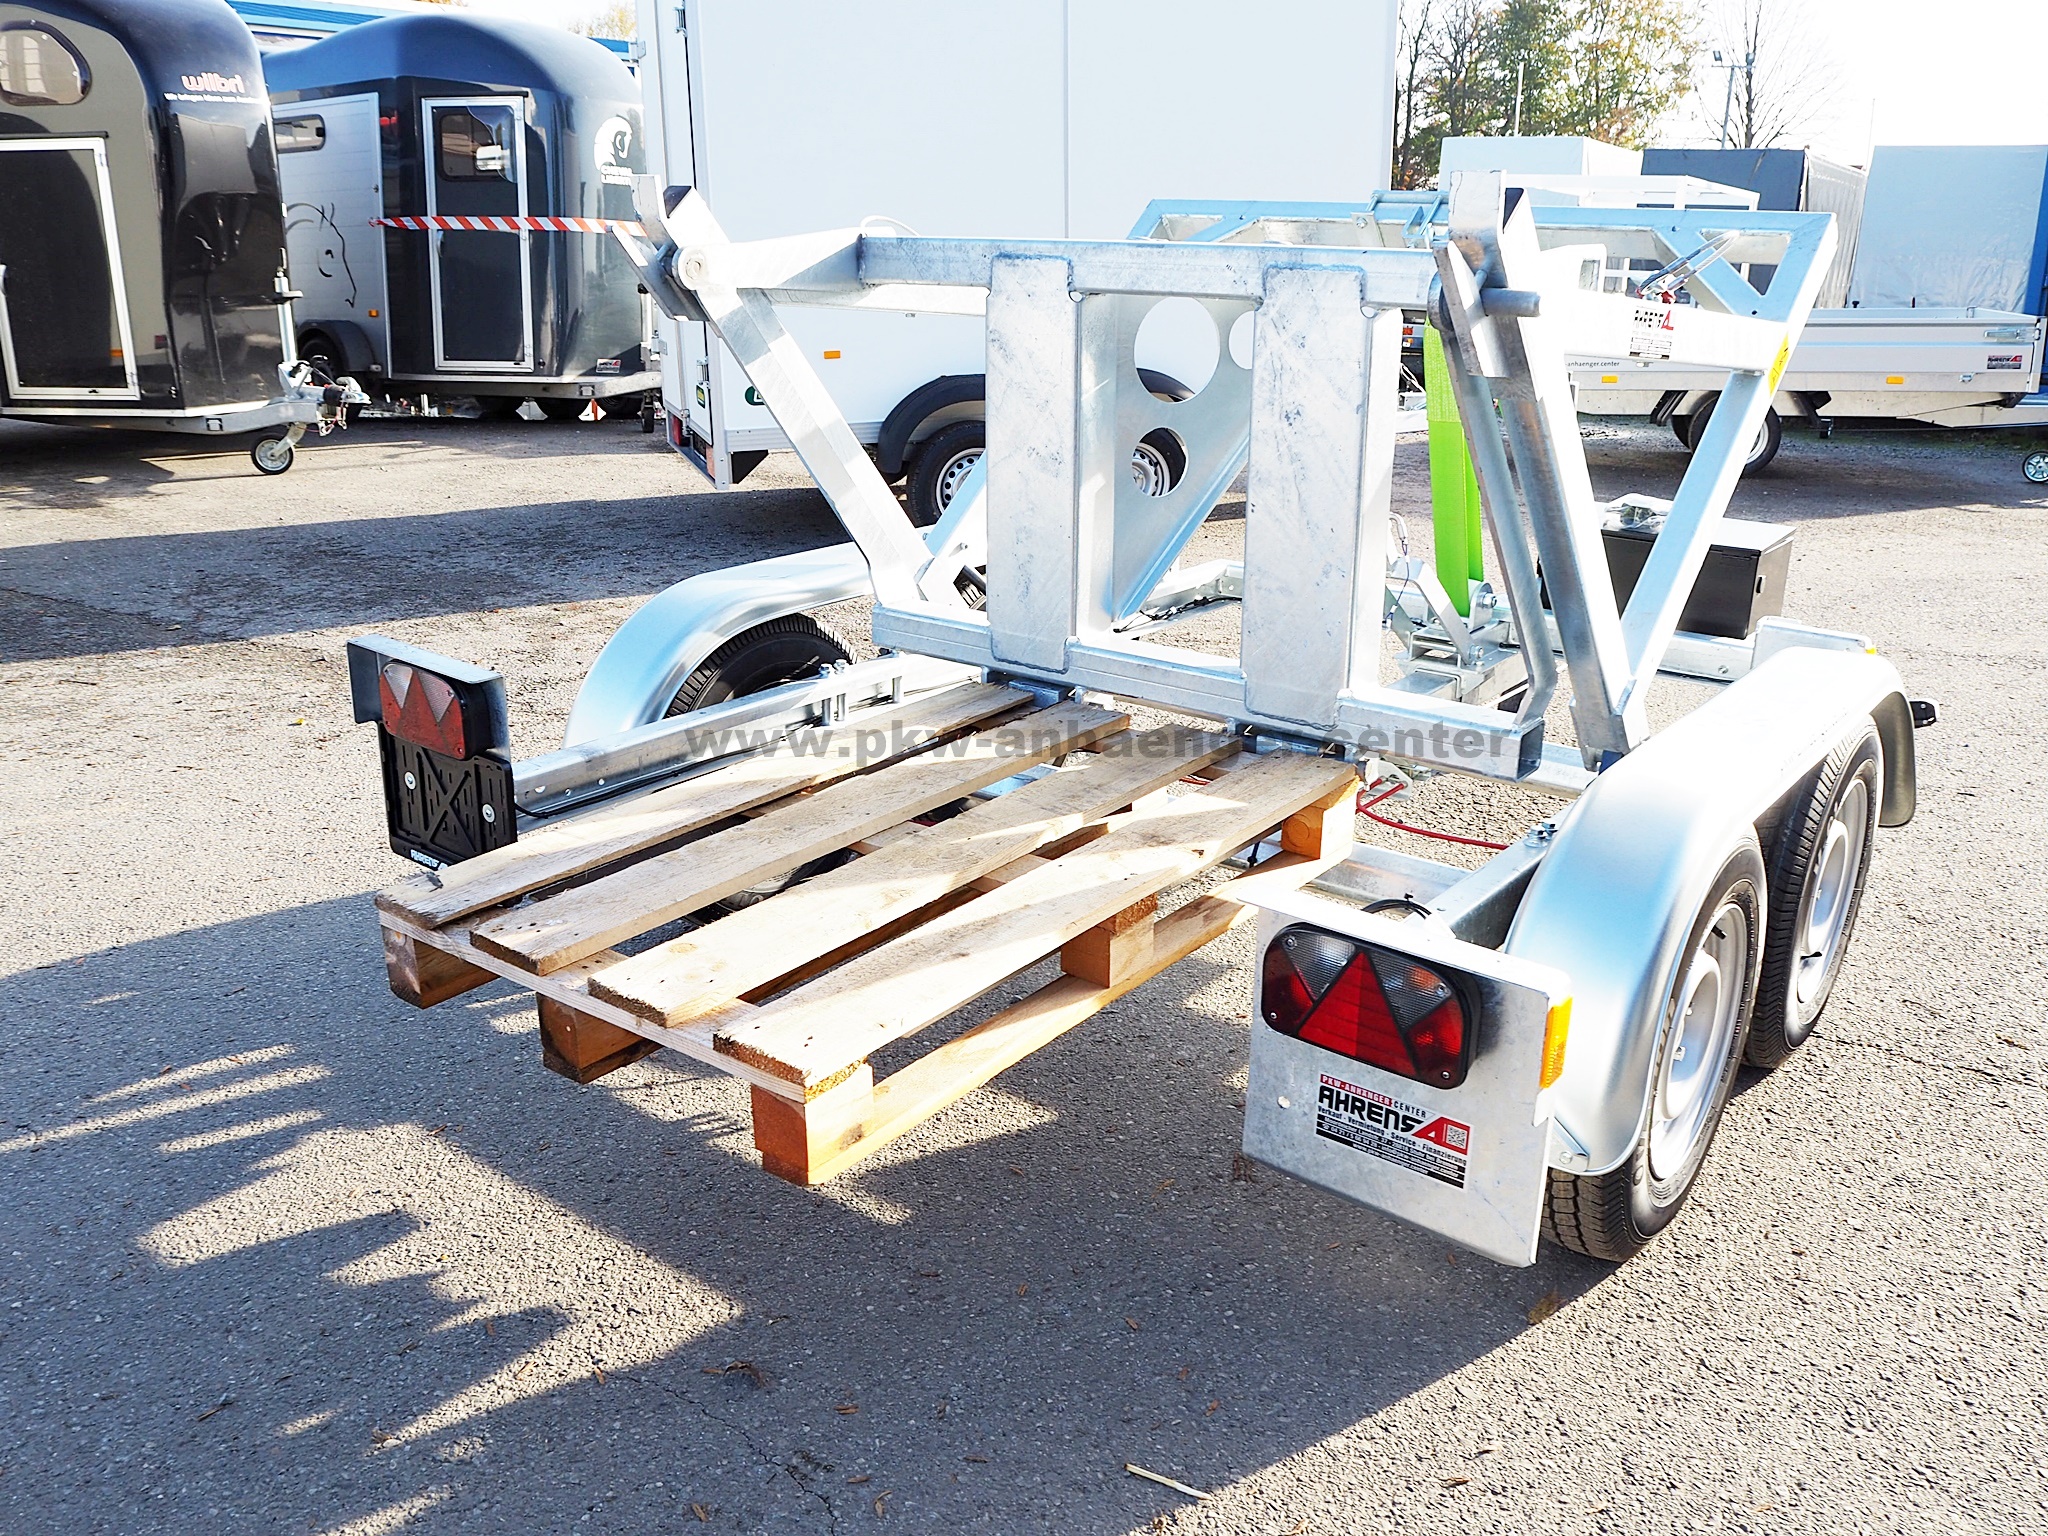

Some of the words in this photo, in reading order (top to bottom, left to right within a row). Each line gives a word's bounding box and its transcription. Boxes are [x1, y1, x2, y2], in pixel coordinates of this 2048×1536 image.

[1565, 360, 1620, 368] -anhaenger.center
[1318, 1085, 1425, 1133] AHRENS
[1318, 1105, 1343, 1119] Verkauf
[1348, 1116, 1385, 1136] Vermietung
[1390, 1131, 1417, 1147] Service
[1422, 1143, 1467, 1166] Finanzierung
